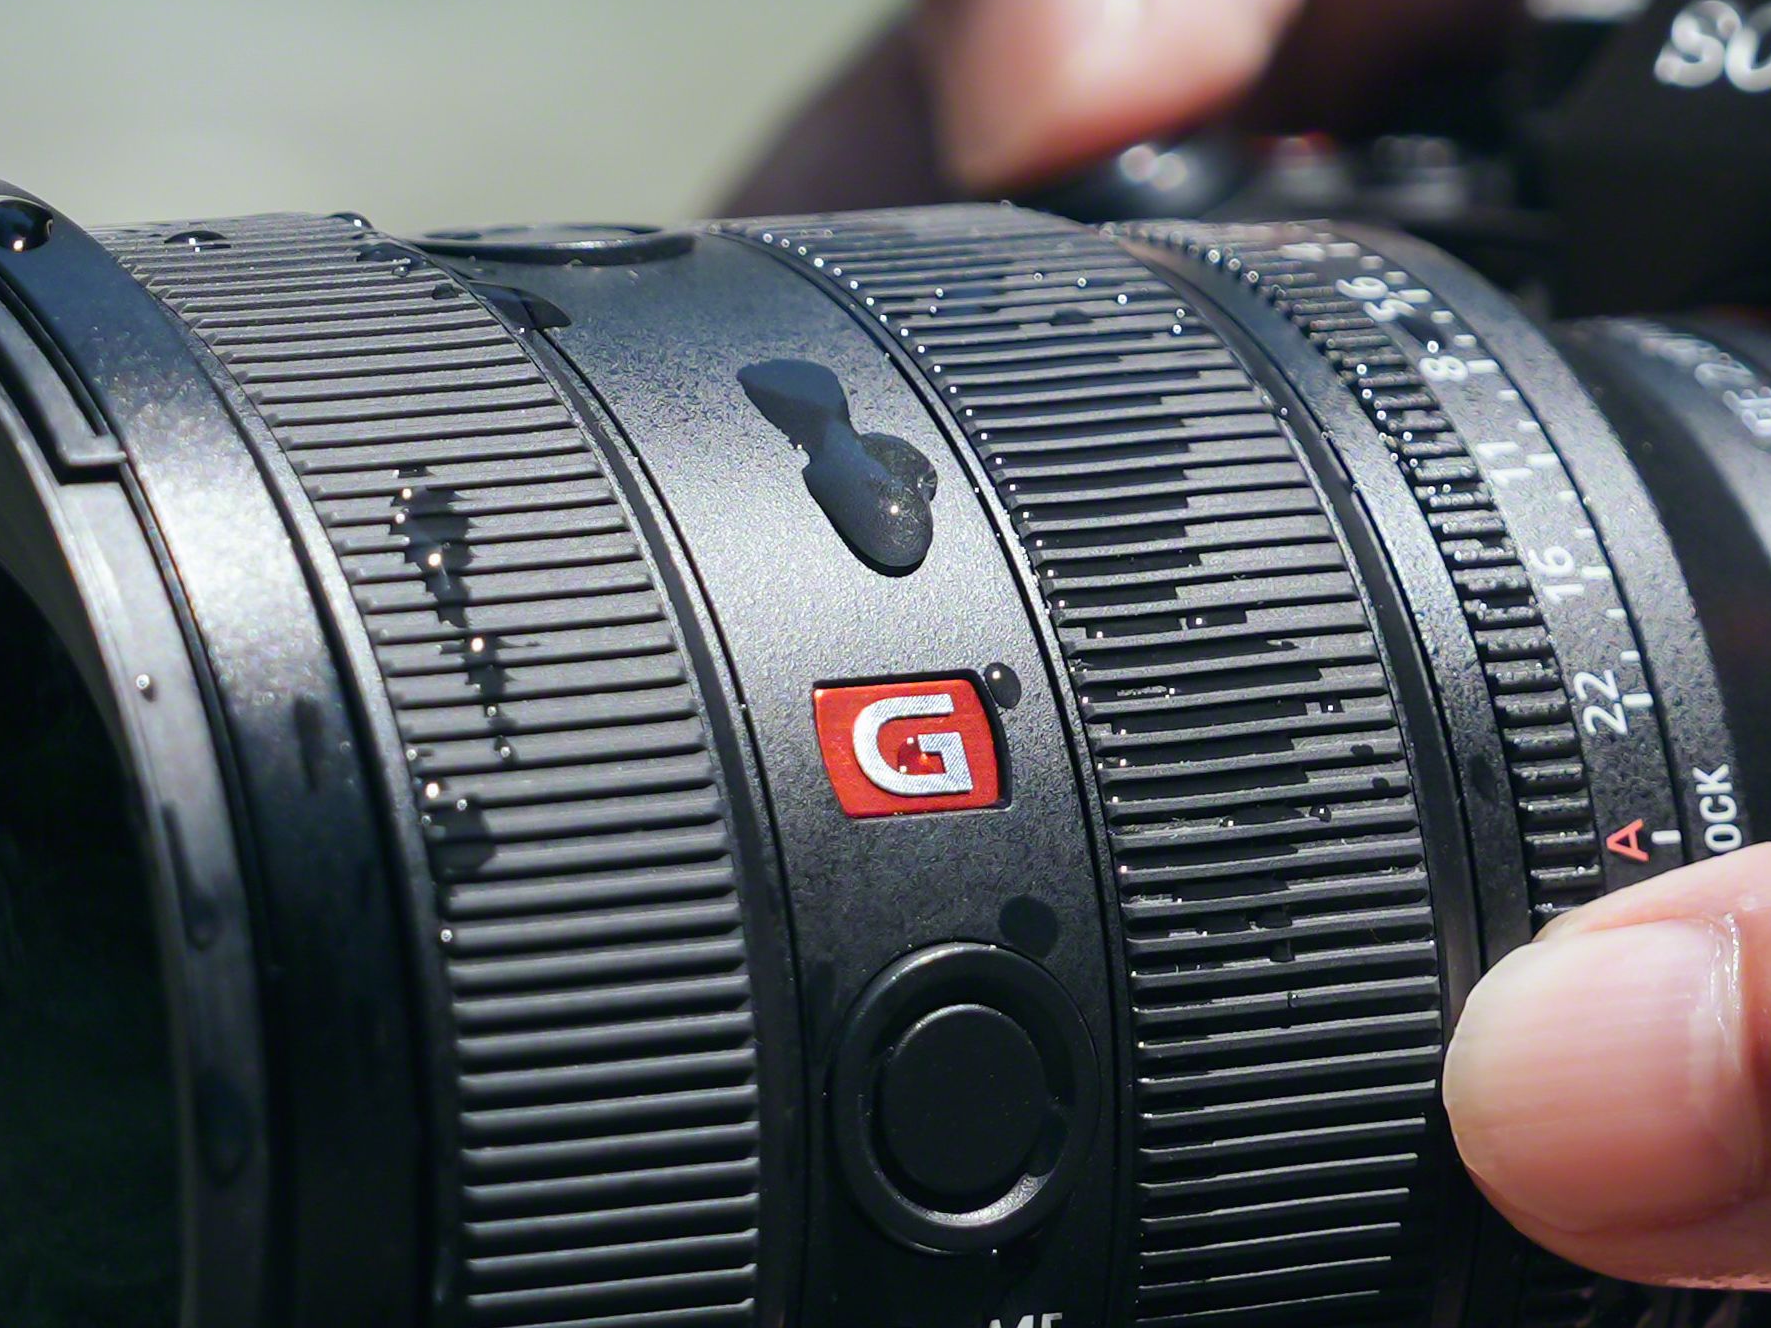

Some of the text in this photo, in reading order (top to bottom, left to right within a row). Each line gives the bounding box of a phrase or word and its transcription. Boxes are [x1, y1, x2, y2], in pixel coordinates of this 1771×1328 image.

[1418, 355, 1468, 382] 8
[1528, 545, 1585, 603] 16
[1574, 669, 1628, 735] 22
[852, 693, 973, 795] G
[1692, 763, 1743, 853] OCK
[1606, 818, 1650, 863] A
